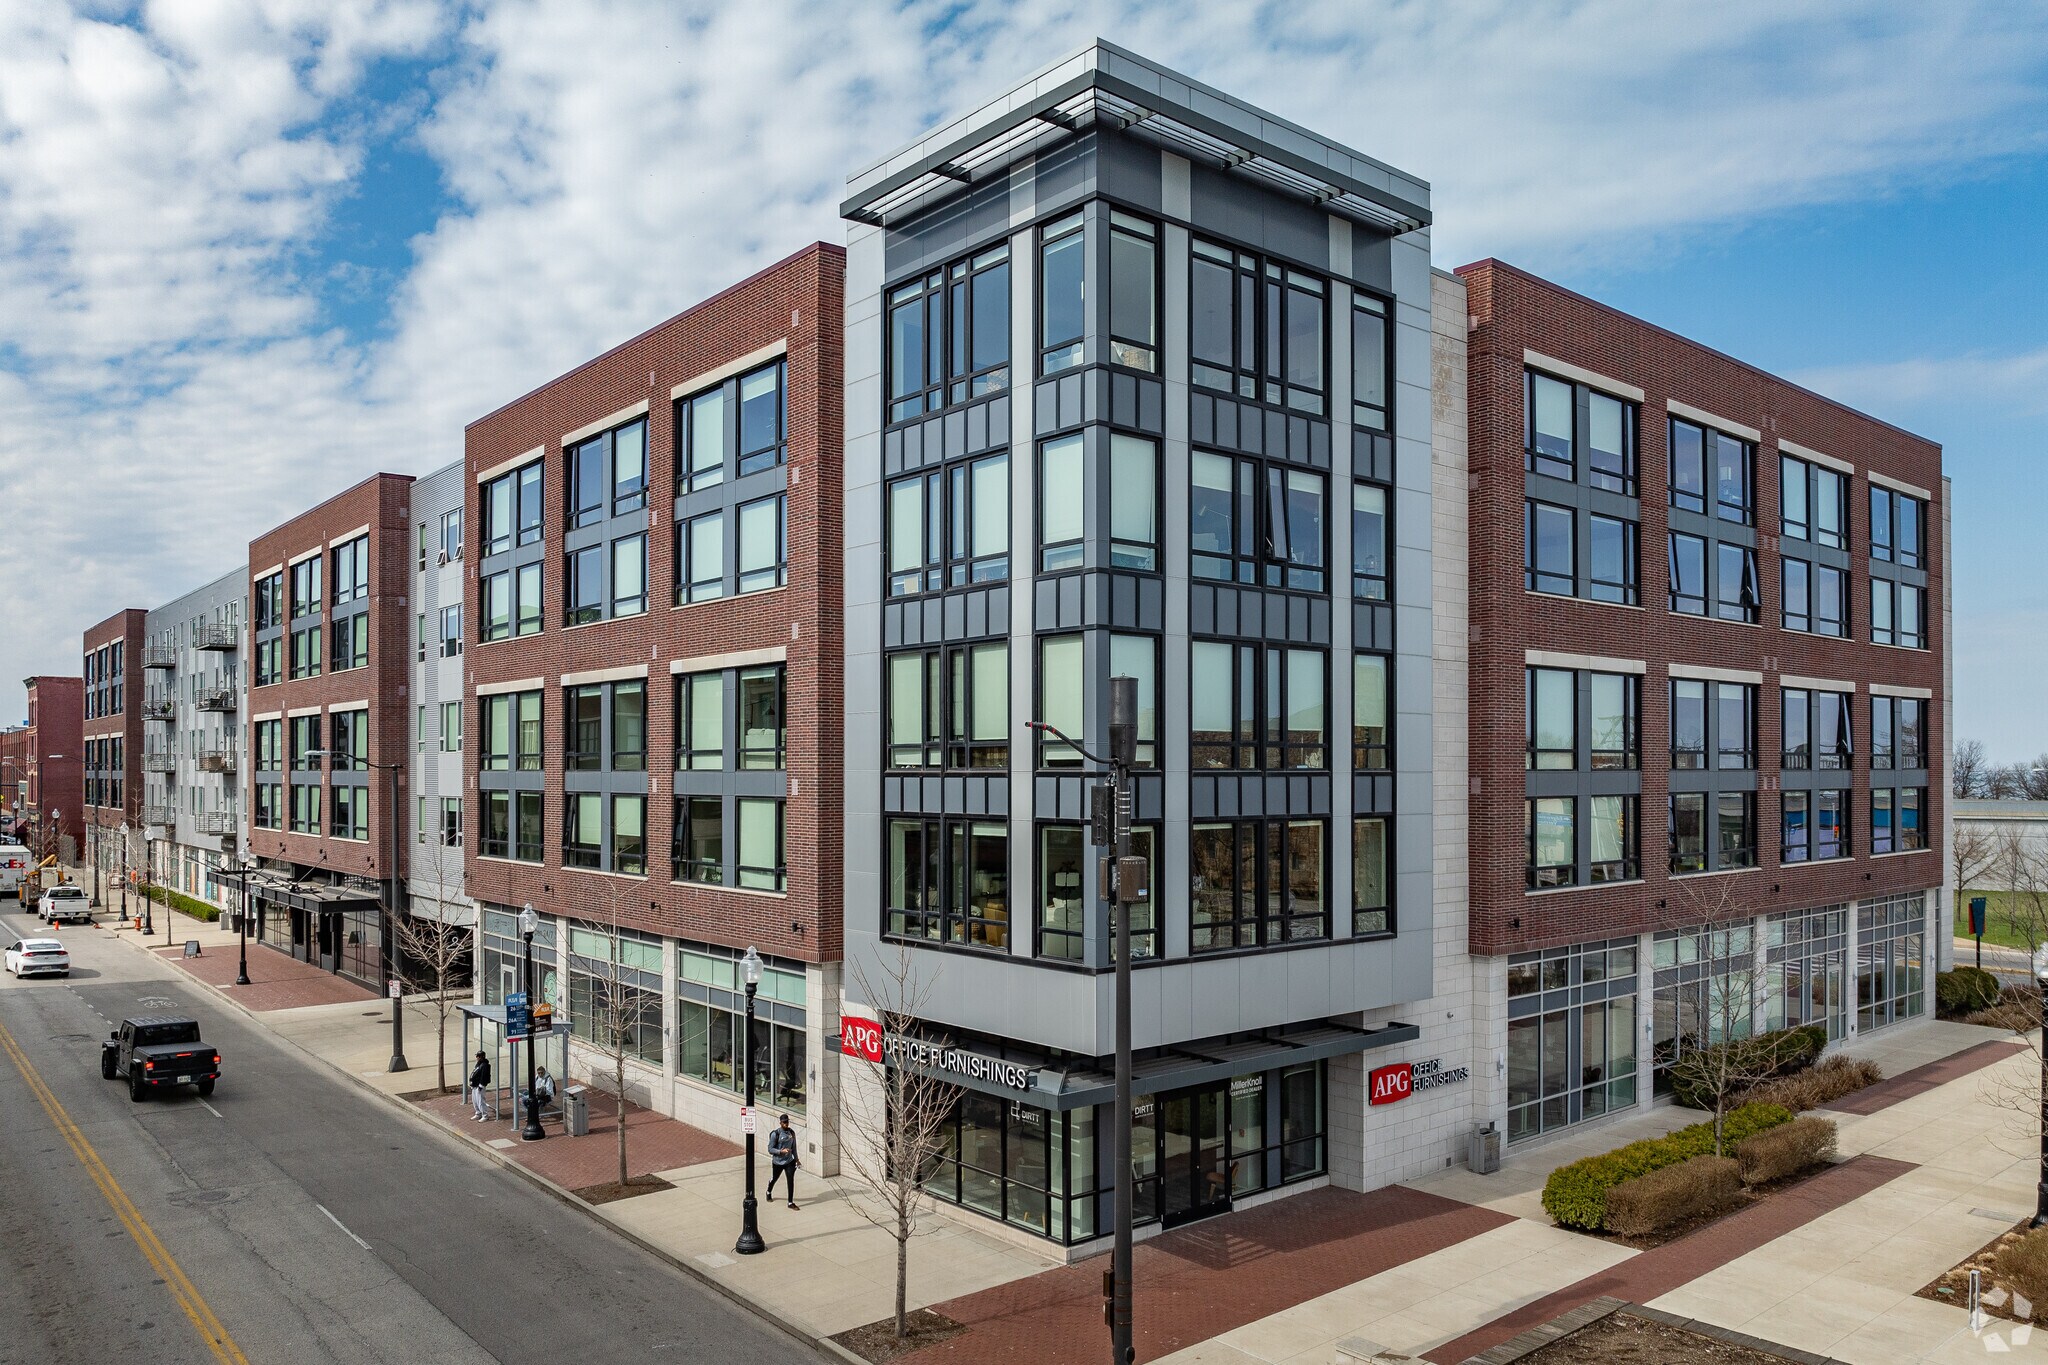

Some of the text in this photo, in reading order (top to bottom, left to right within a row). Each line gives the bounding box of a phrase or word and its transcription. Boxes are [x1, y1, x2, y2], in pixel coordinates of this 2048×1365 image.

[844, 1024, 879, 1053] APG
[931, 1048, 1026, 1089] FURNISHINGS
[1413, 1059, 1443, 1077] OFFICE
[1231, 1076, 1262, 1091] MillerKnoll
[1374, 1070, 1408, 1098] APG
[1413, 1067, 1469, 1092] FURNISHINGS
[1021, 1110, 1040, 1123] DIRTT
[1134, 1103, 1154, 1115] DIRTT
